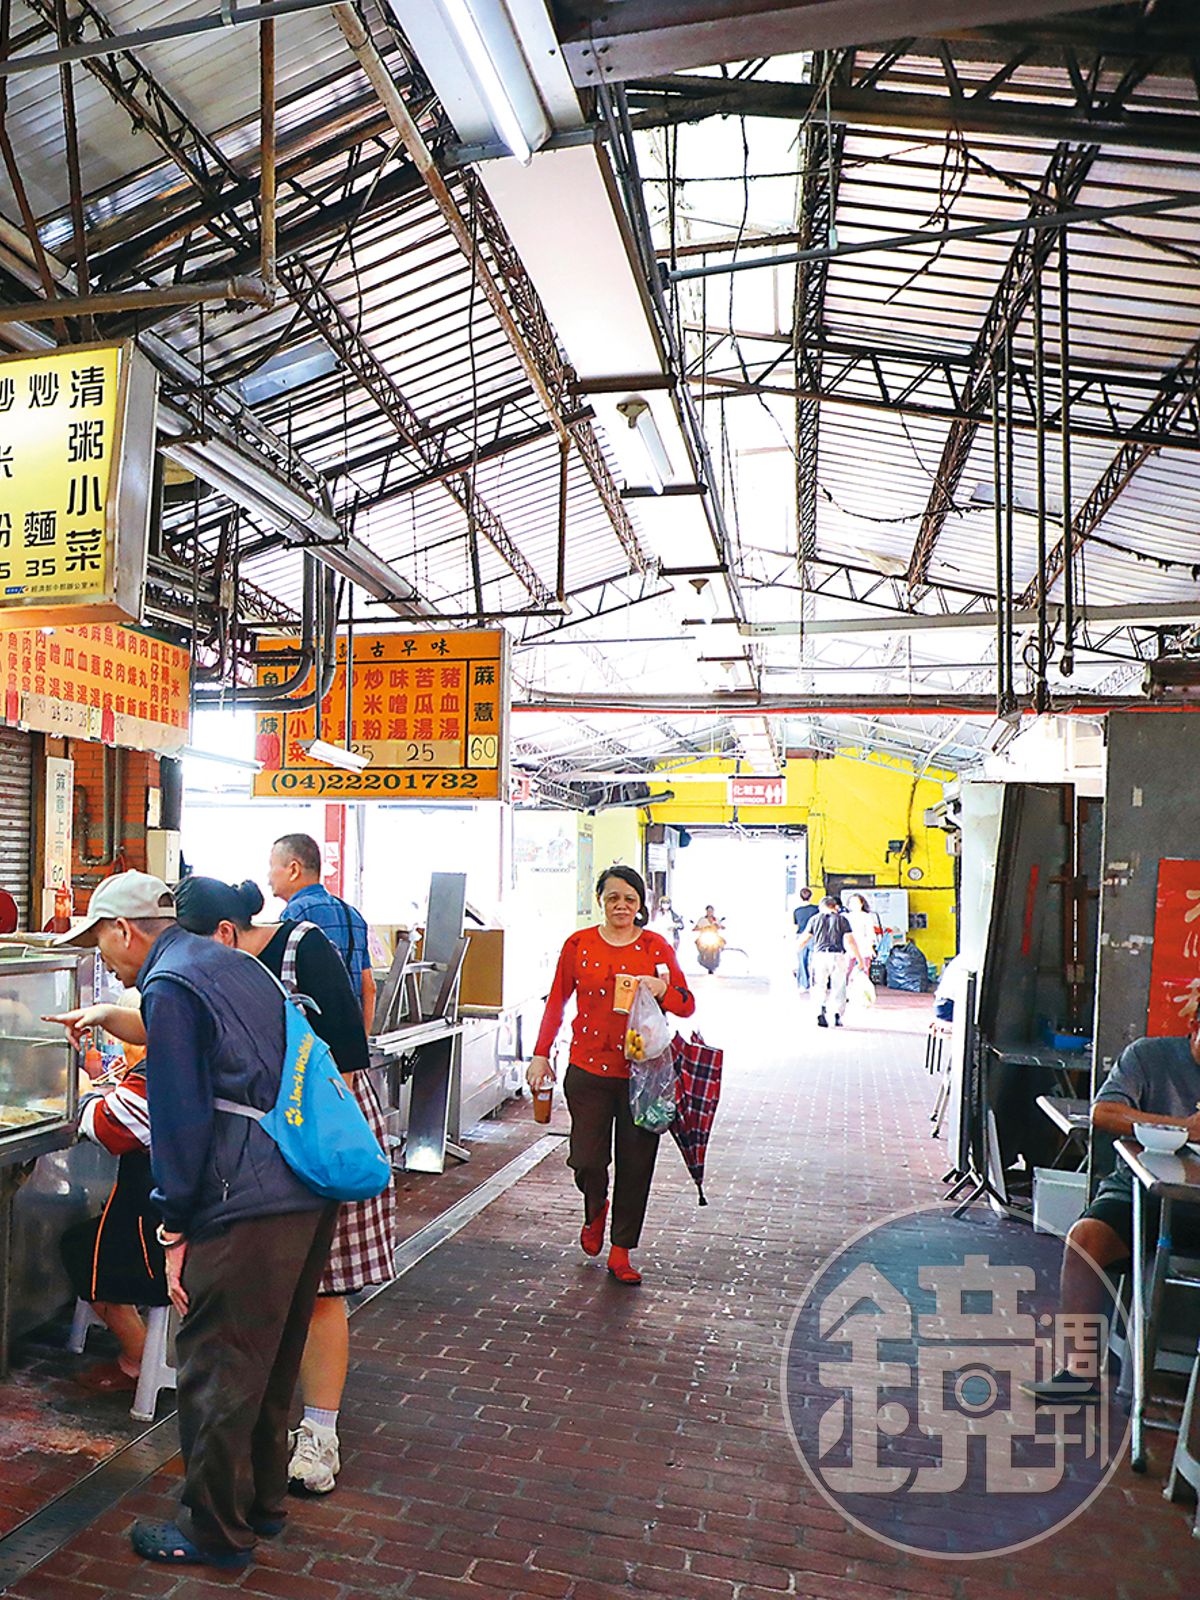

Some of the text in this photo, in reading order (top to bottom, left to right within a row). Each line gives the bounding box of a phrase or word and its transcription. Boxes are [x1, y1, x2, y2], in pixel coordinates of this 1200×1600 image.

[24, 371, 60, 548] 炒麵
[65, 366, 105, 571] 清粥小菜
[26, 559, 56, 577] 35
[362, 669, 384, 741] 炒米粉
[387, 669, 410, 741] 味噌湯
[412, 667, 436, 740] 苦瓜湯
[438, 667, 461, 740] 豬血湯
[272, 773, 479, 794] (04)22201732
[406, 743, 435, 762] 25
[470, 735, 496, 761] 60
[289, 1073, 303, 1107] Jack
